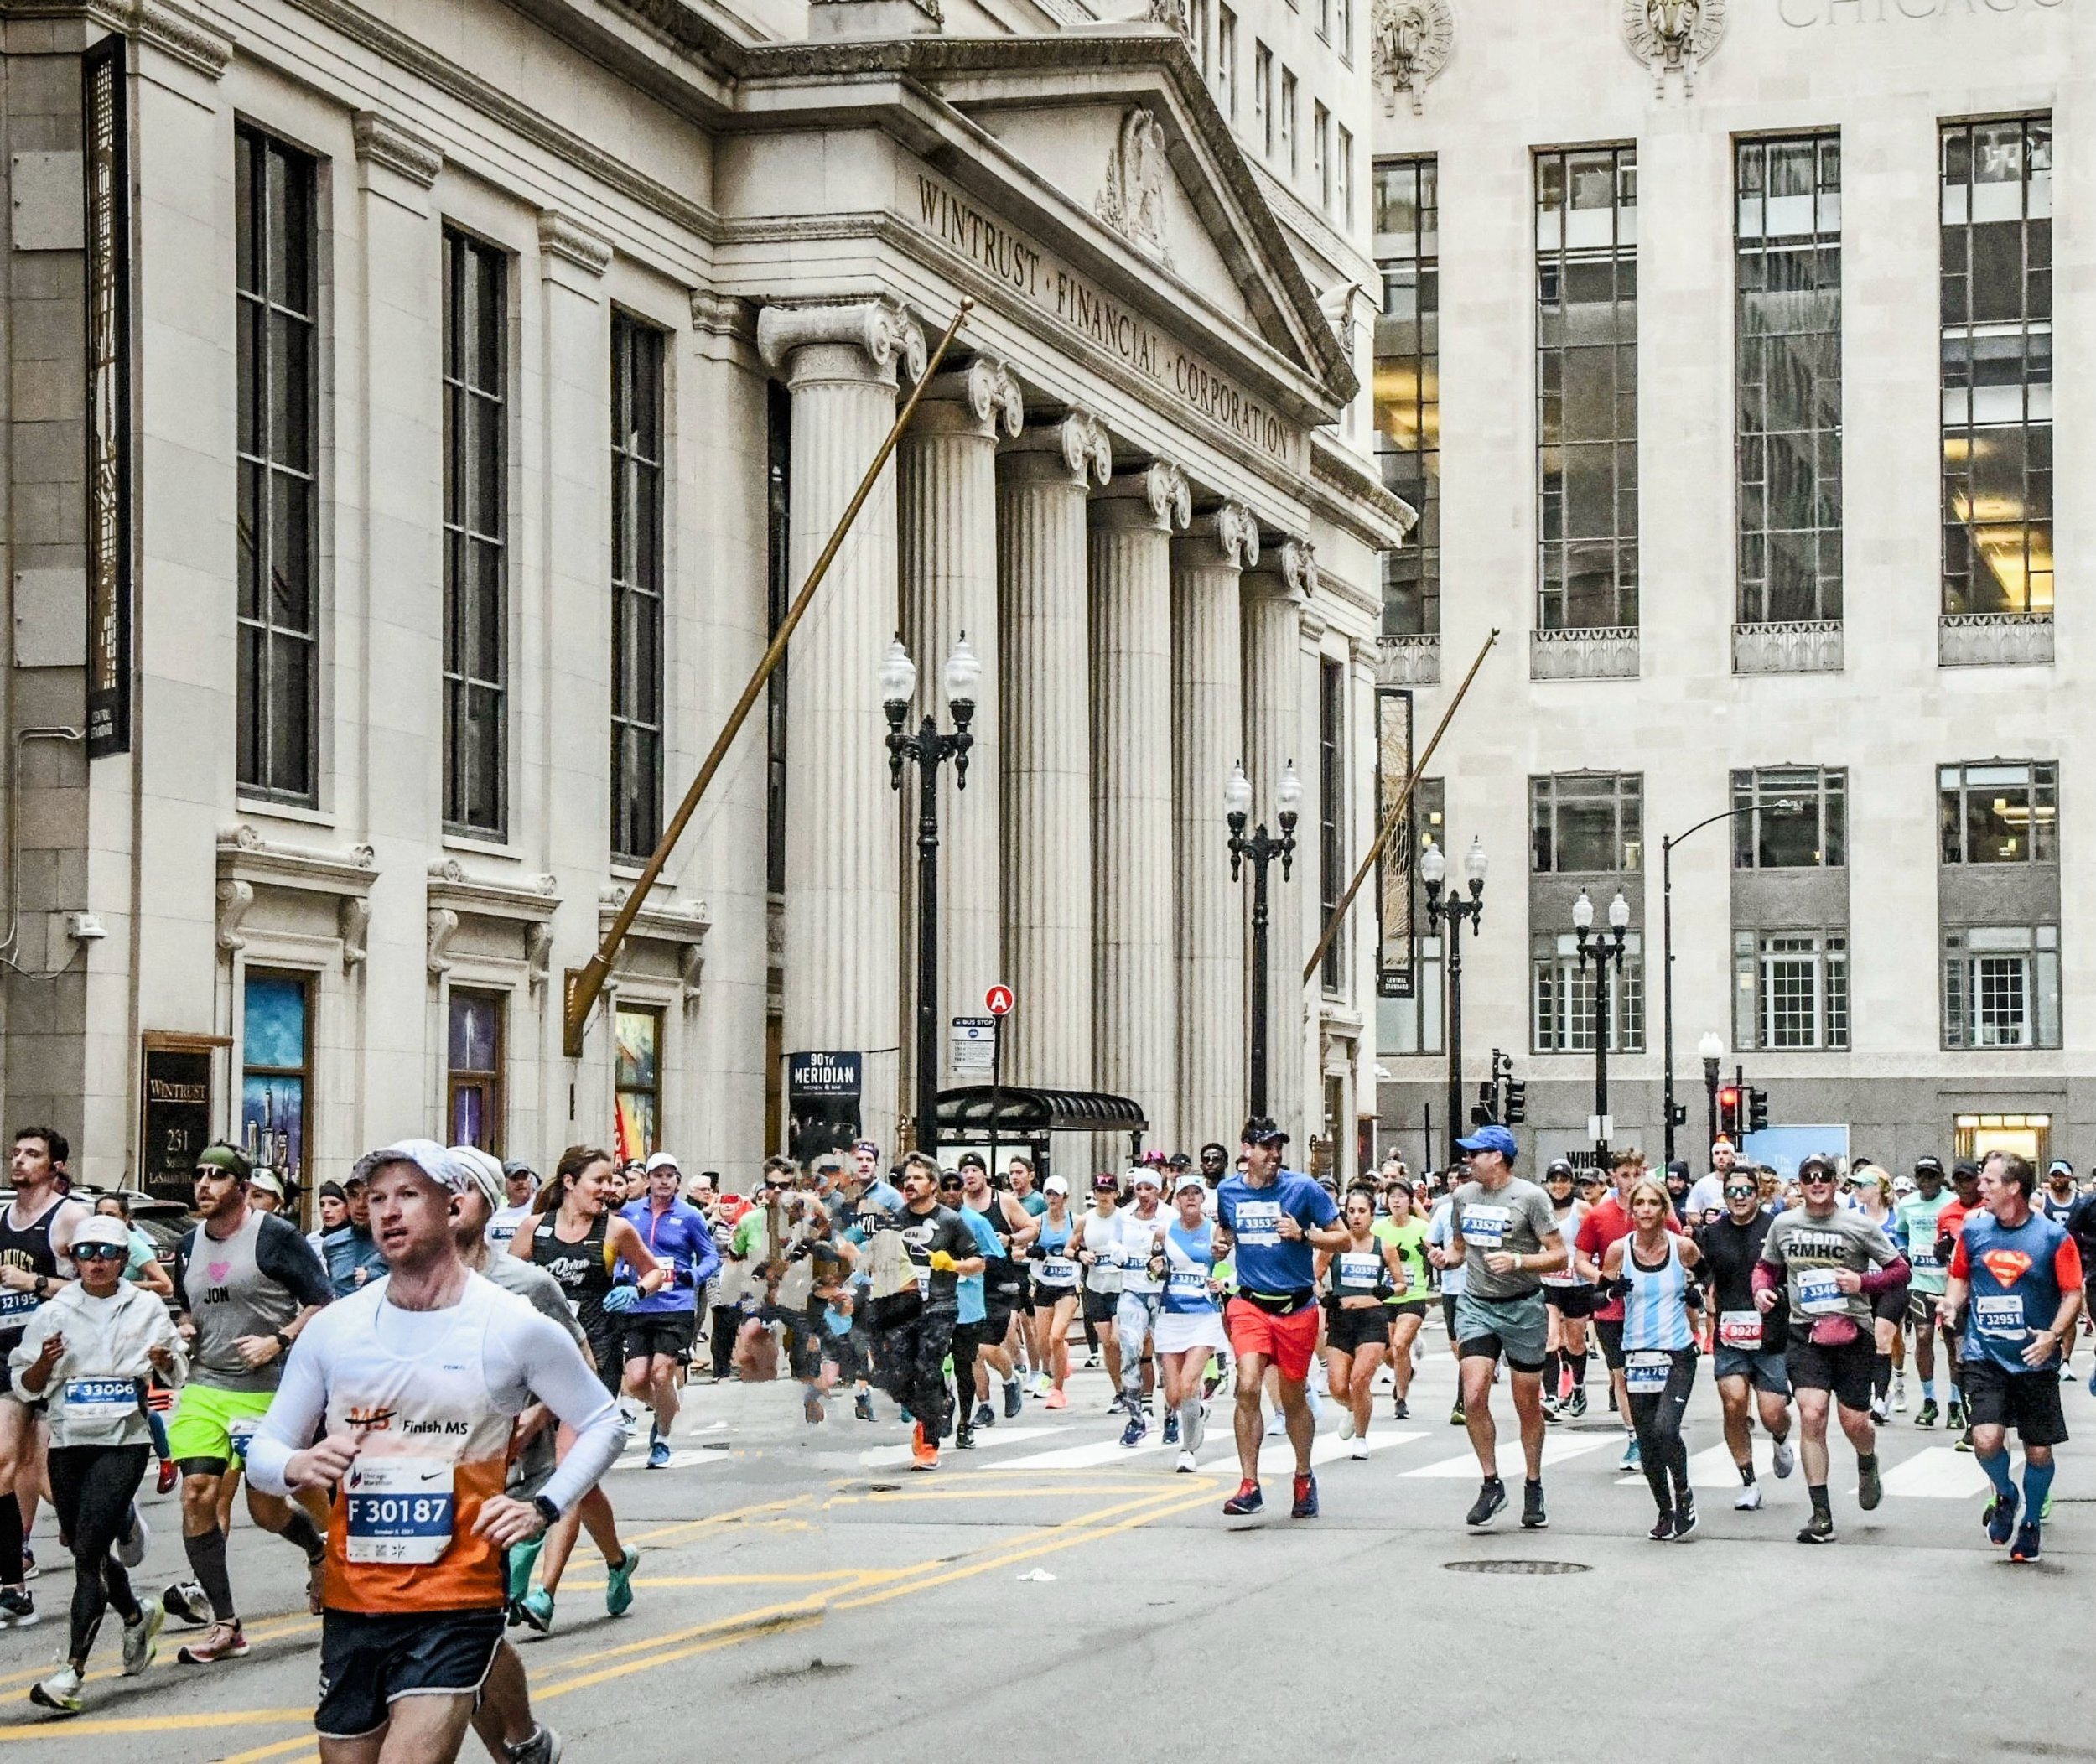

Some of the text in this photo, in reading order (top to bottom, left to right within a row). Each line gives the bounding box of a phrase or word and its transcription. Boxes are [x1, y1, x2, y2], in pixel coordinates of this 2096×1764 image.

[919, 174, 1288, 460] WINTRUST FINANCIAL CORPORATION
[990, 990, 1008, 1009] A
[795, 1066, 854, 1084] MERIDIAN
[167, 1129, 188, 1151] 231
[1566, 1151, 1614, 1169] WHEE
[1237, 1218, 1243, 1229] F
[1462, 1218, 1469, 1229] F
[1791, 1229, 1842, 1246] Team
[1787, 1244, 1845, 1258] RMHC
[0, 1248, 34, 1273] NUET
[204, 1286, 230, 1305] JON
[1801, 1284, 1840, 1298] F 3346
[2, 1293, 38, 1308] 32195
[1979, 1313, 2021, 1325] F 32951
[67, 1385, 78, 1398] F
[403, 1420, 468, 1435] Finish MS
[231, 1438, 240, 1450] F
[348, 1499, 447, 1523] F 30187
